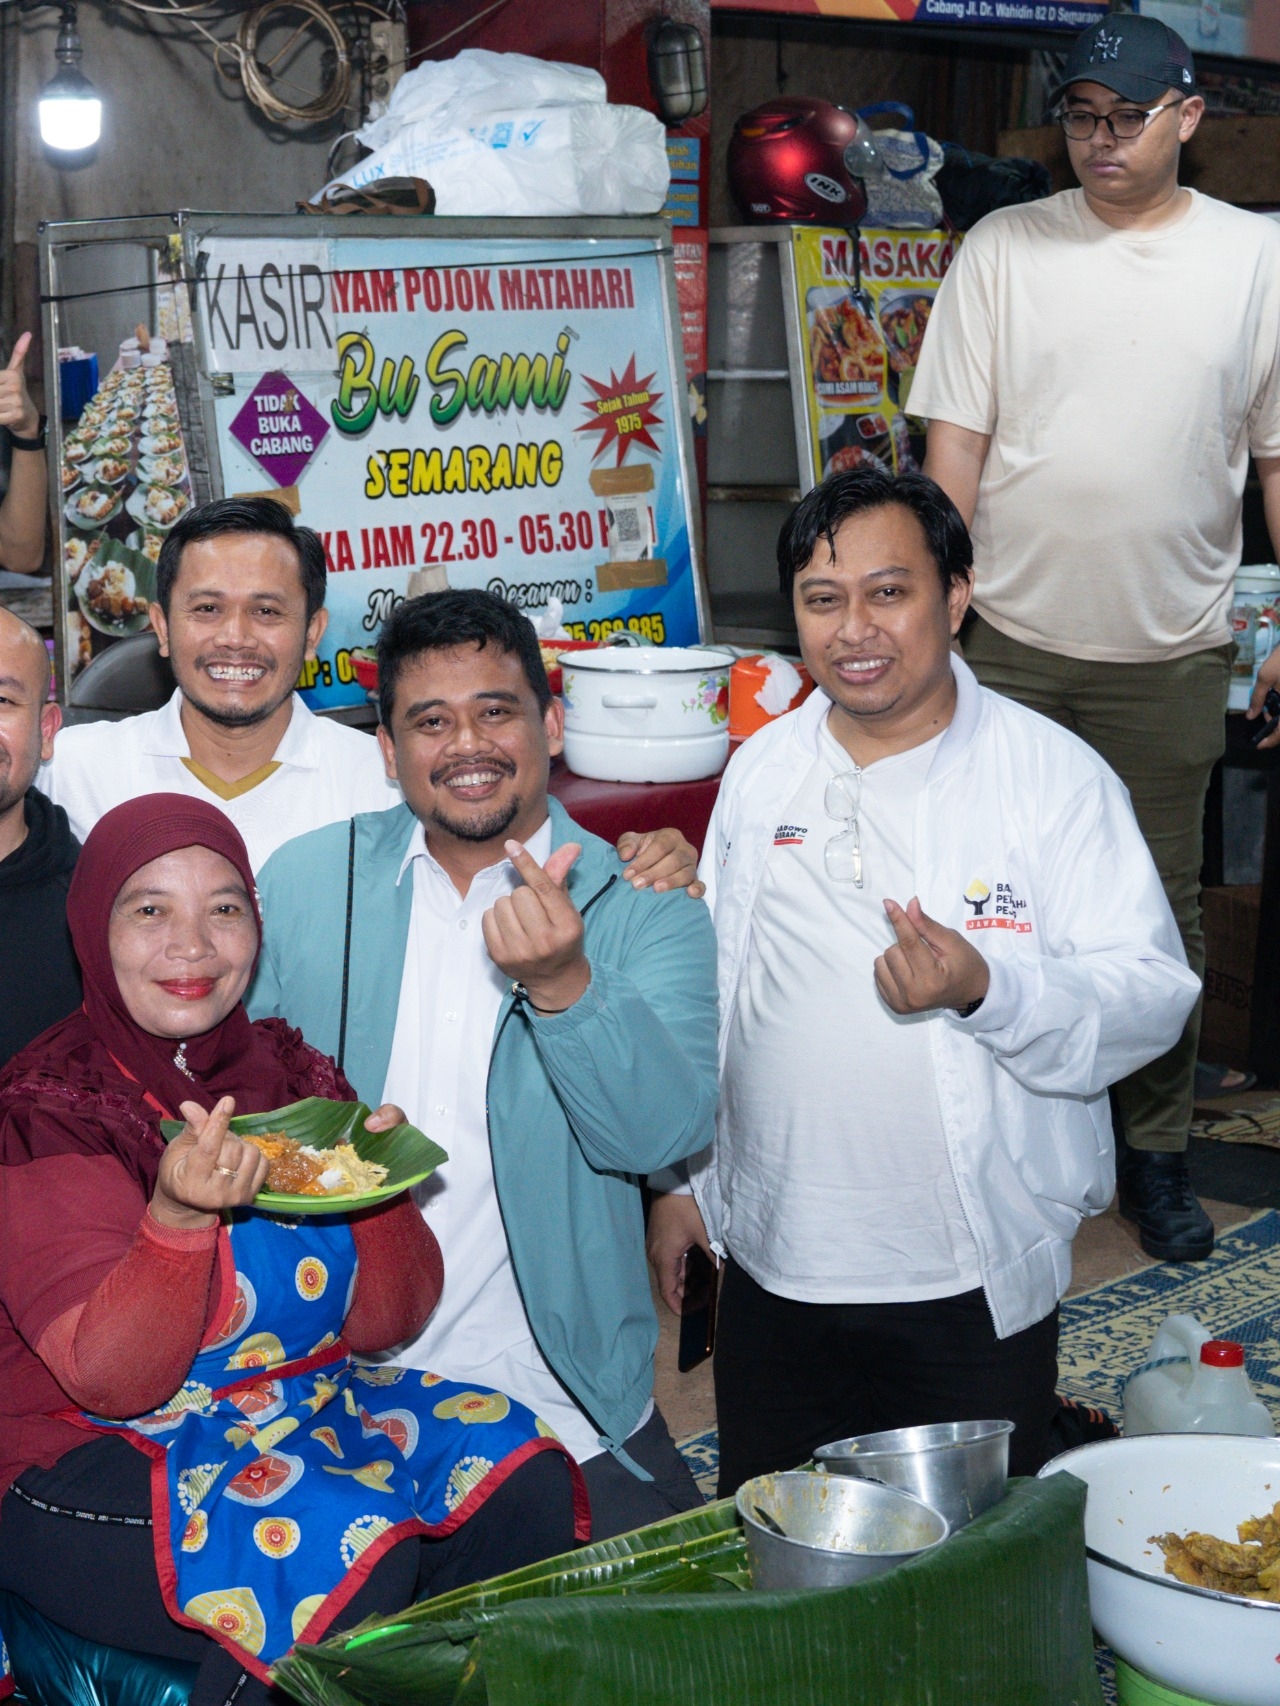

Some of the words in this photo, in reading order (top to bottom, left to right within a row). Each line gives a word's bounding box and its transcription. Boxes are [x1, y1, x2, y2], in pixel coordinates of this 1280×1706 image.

[926, 0, 964, 18] Cabang
[810, 176, 842, 197] INK
[822, 238, 955, 279] MASAKA
[403, 267, 496, 314] POJOK
[499, 266, 635, 313] MATAHARI
[204, 262, 334, 351] KASIR
[330, 329, 421, 435] Bu
[425, 328, 572, 427] Sami
[596, 396, 624, 415] Sejak
[621, 391, 651, 408] Tahun
[257, 414, 302, 435] BUKA
[614, 411, 643, 435] 1975
[249, 434, 314, 457] CABANG
[364, 439, 564, 500] SEMARANG
[319, 529, 357, 574] KA
[360, 524, 416, 571] JAM
[420, 517, 499, 565] 22.30
[518, 509, 595, 556] 05.30
